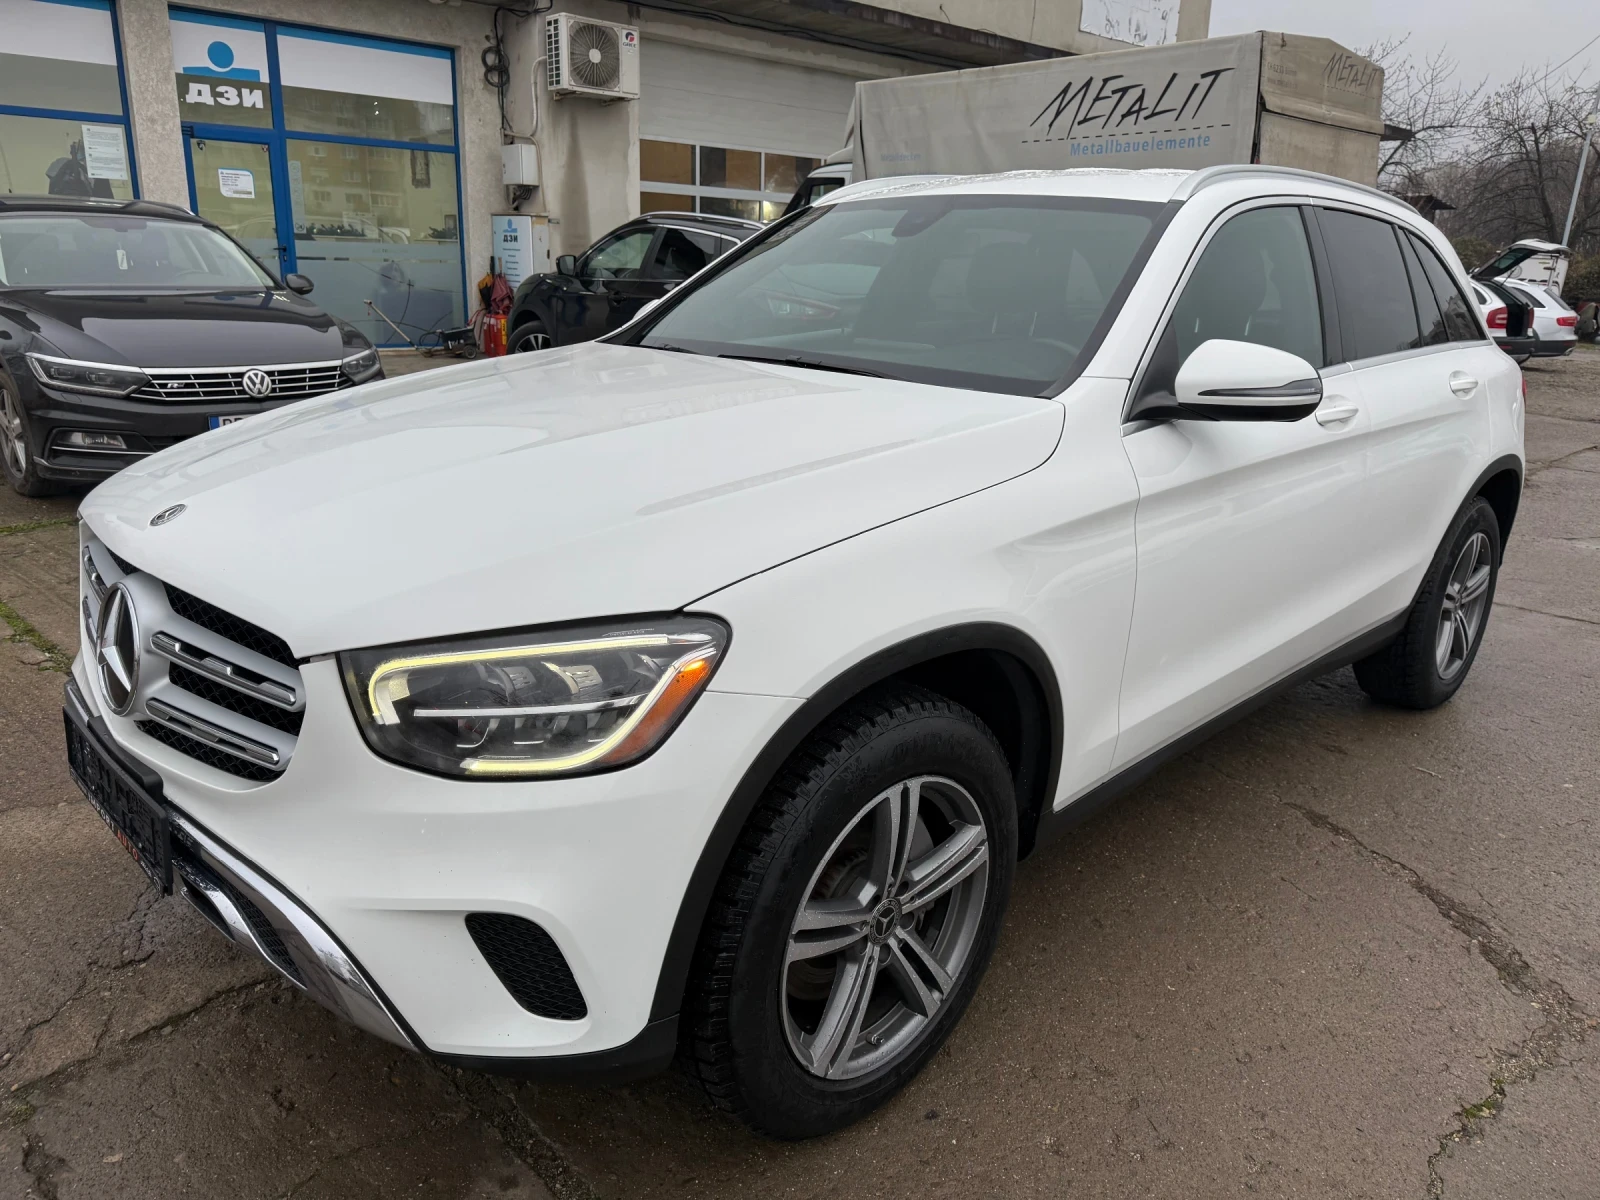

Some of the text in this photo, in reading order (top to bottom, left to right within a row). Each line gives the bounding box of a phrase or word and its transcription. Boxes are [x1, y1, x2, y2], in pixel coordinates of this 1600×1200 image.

[1322, 52, 1379, 92] METALIT
[185, 82, 264, 109] ДЗИ
[1029, 67, 1236, 139] METALIT
[1070, 134, 1211, 157] Metallbauelemente
[503, 234, 519, 243] ДЗИ
[116, 829, 139, 861] AUTO
